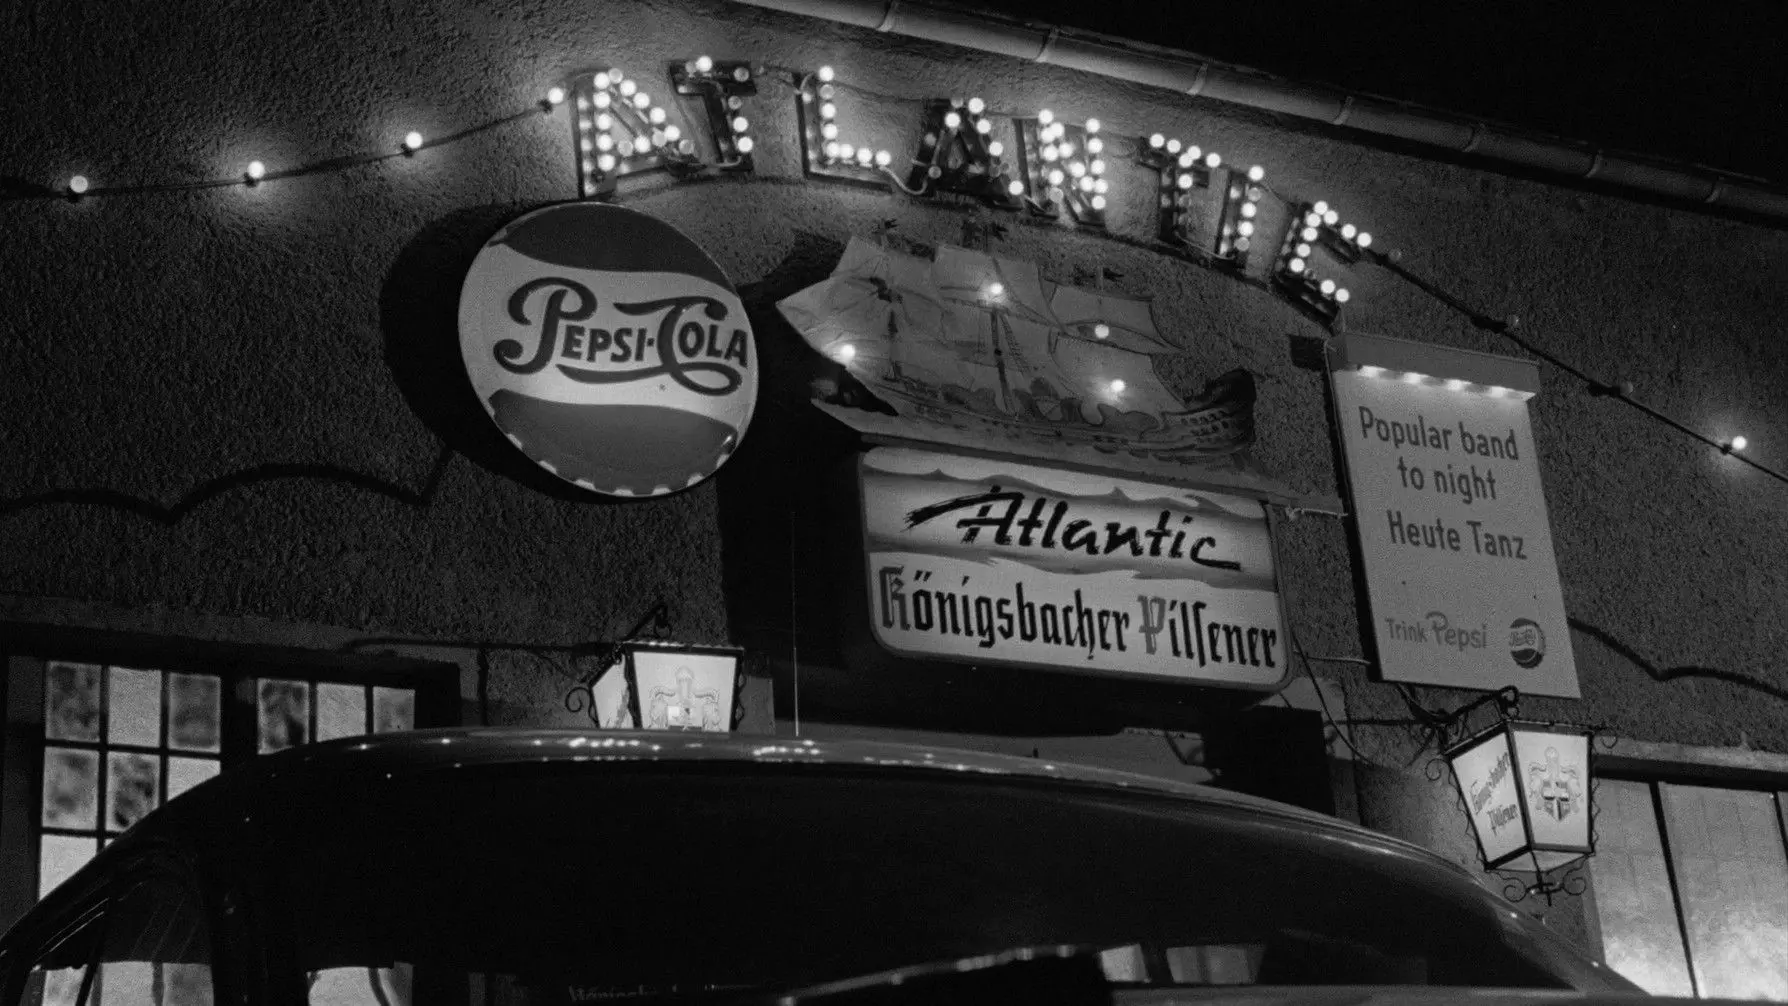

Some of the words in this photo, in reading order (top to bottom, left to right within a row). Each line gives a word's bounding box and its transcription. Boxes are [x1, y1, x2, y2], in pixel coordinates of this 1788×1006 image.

[567, 55, 1374, 327] ATLANTIC
[1358, 405, 1453, 450] Popular
[1458, 421, 1519, 460] band
[1397, 455, 1425, 490] to
[1433, 464, 1497, 504] night
[900, 484, 1242, 572] Atlantic
[1386, 509, 1462, 551] Heute
[1465, 519, 1528, 560] Tanz
[878, 565, 1131, 660] Königsbacher
[1384, 617, 1428, 643] Trink
[1425, 610, 1488, 652] Pepsi
